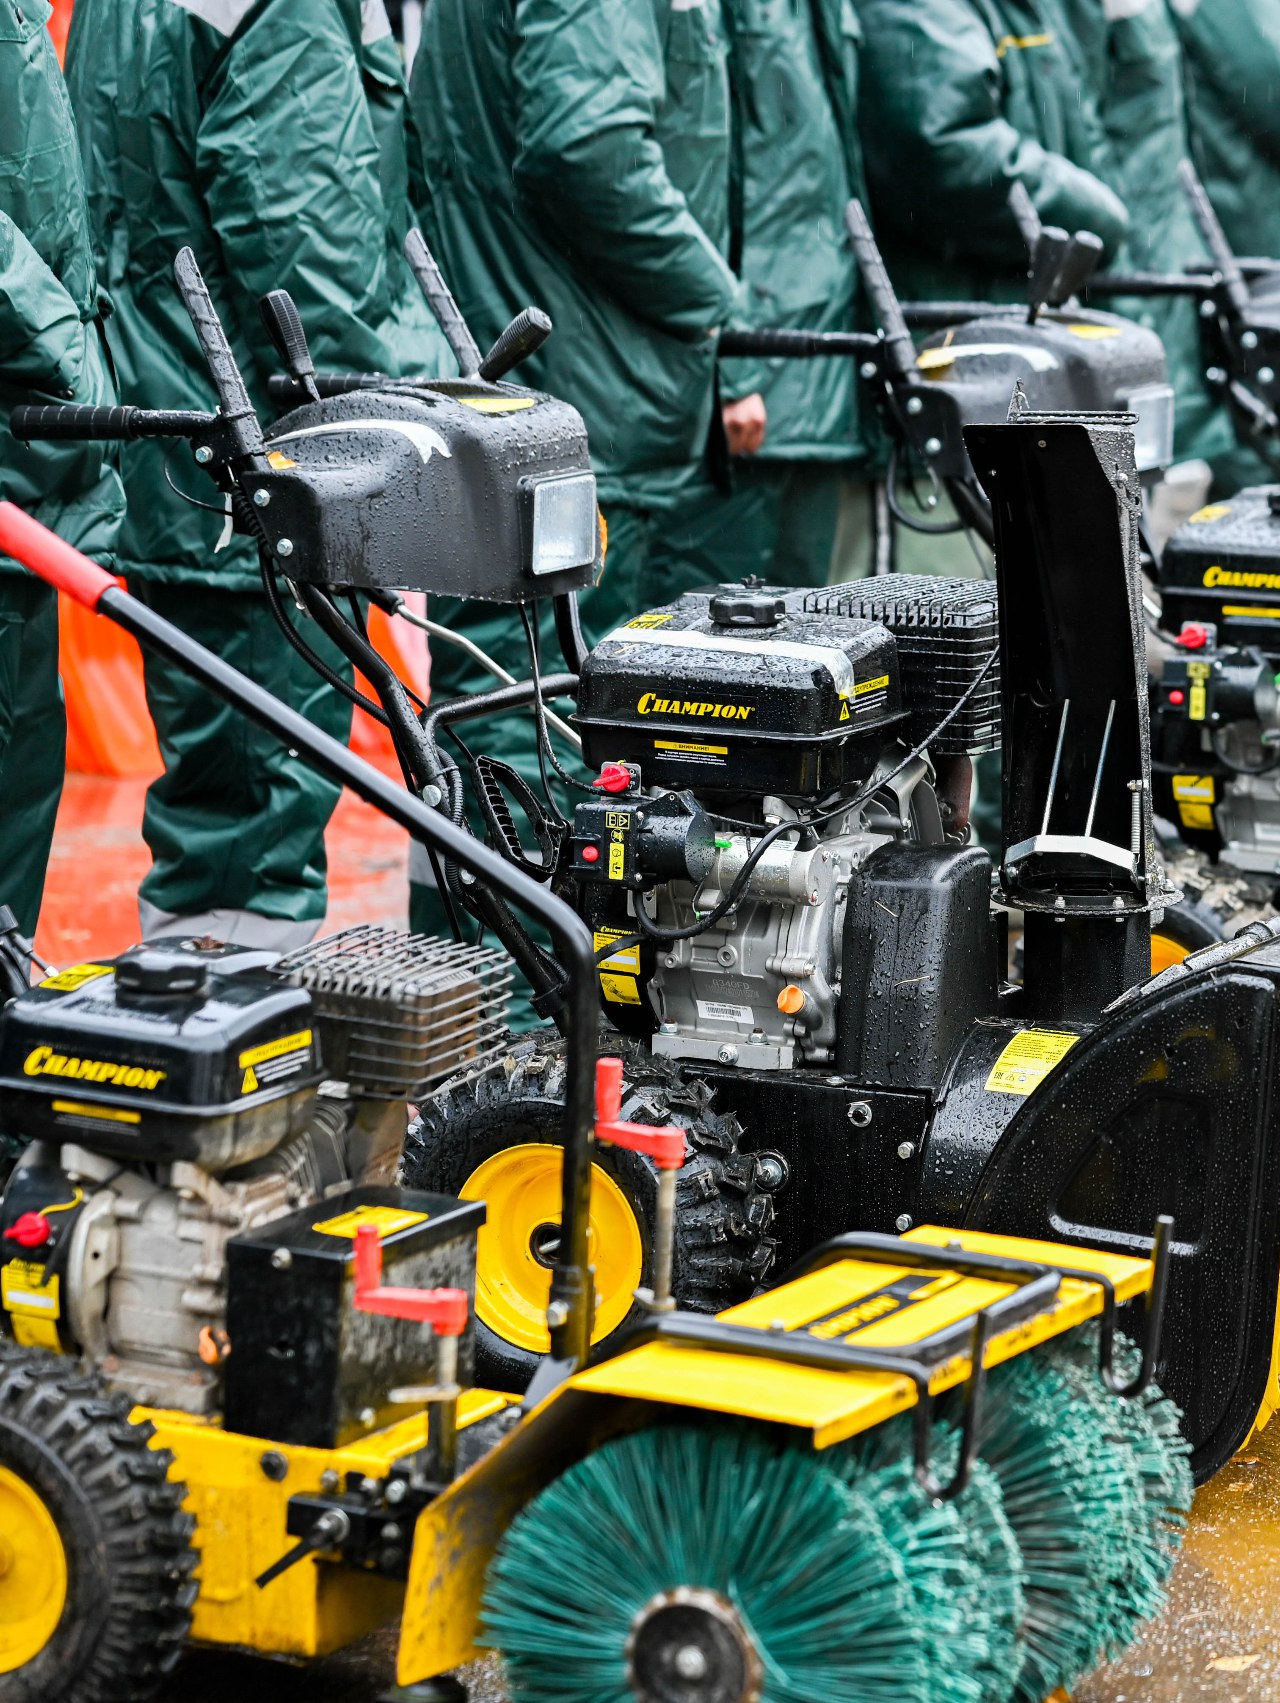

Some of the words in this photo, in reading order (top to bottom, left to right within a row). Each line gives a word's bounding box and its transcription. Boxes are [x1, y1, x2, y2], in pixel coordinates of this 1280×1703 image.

[637, 693, 752, 720] CHAMPION
[600, 925, 633, 935] CHAMPION
[24, 1046, 167, 1090] CHAMPION
